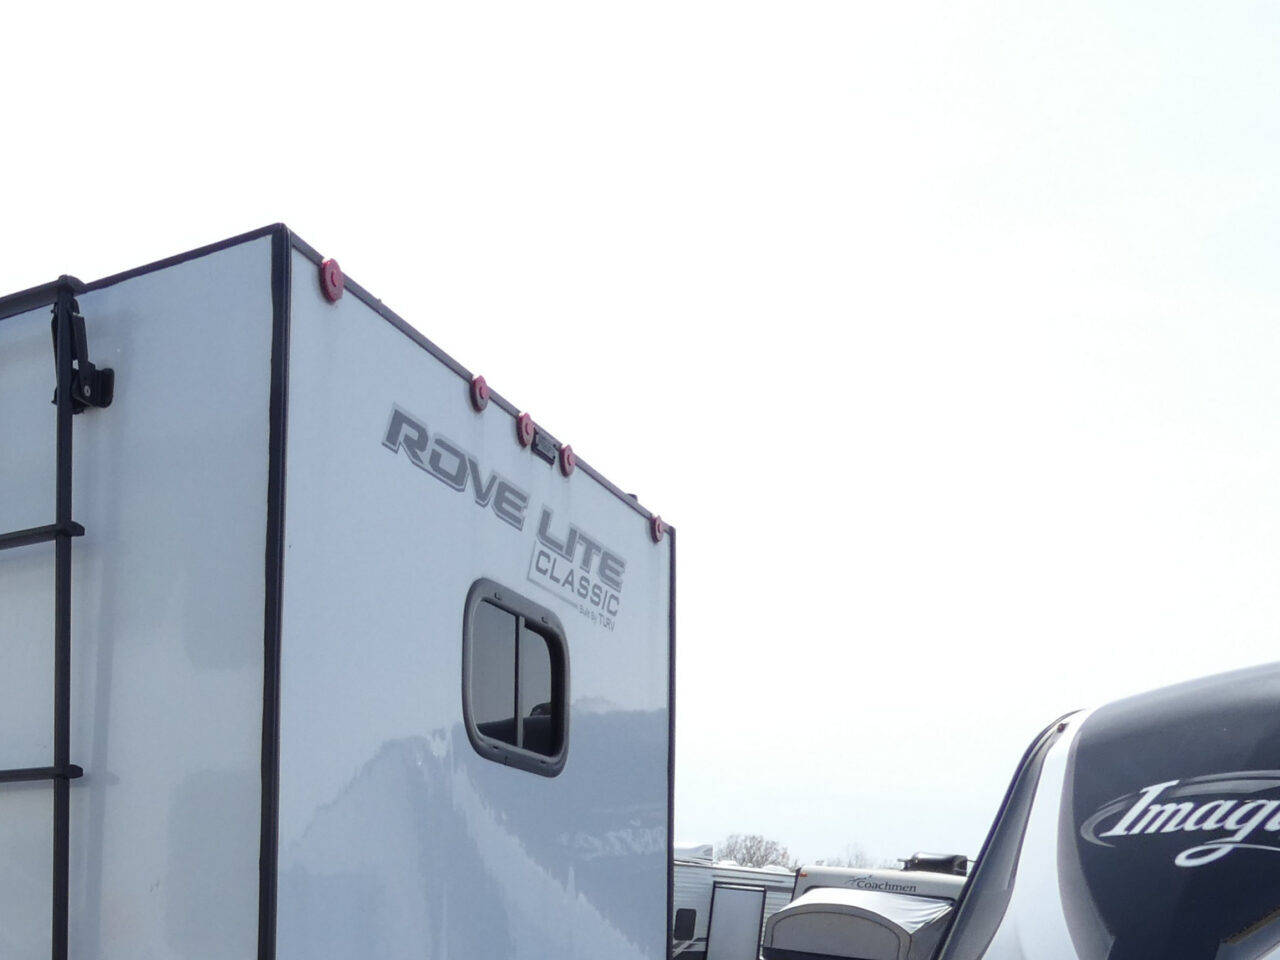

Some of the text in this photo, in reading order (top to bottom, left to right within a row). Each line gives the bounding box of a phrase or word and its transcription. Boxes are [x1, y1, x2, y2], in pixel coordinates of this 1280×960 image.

[381, 402, 627, 594] ROVE LITE
[535, 550, 620, 617] CLASSIC
[598, 611, 616, 633] TLRV
[856, 880, 917, 893] Coachmen
